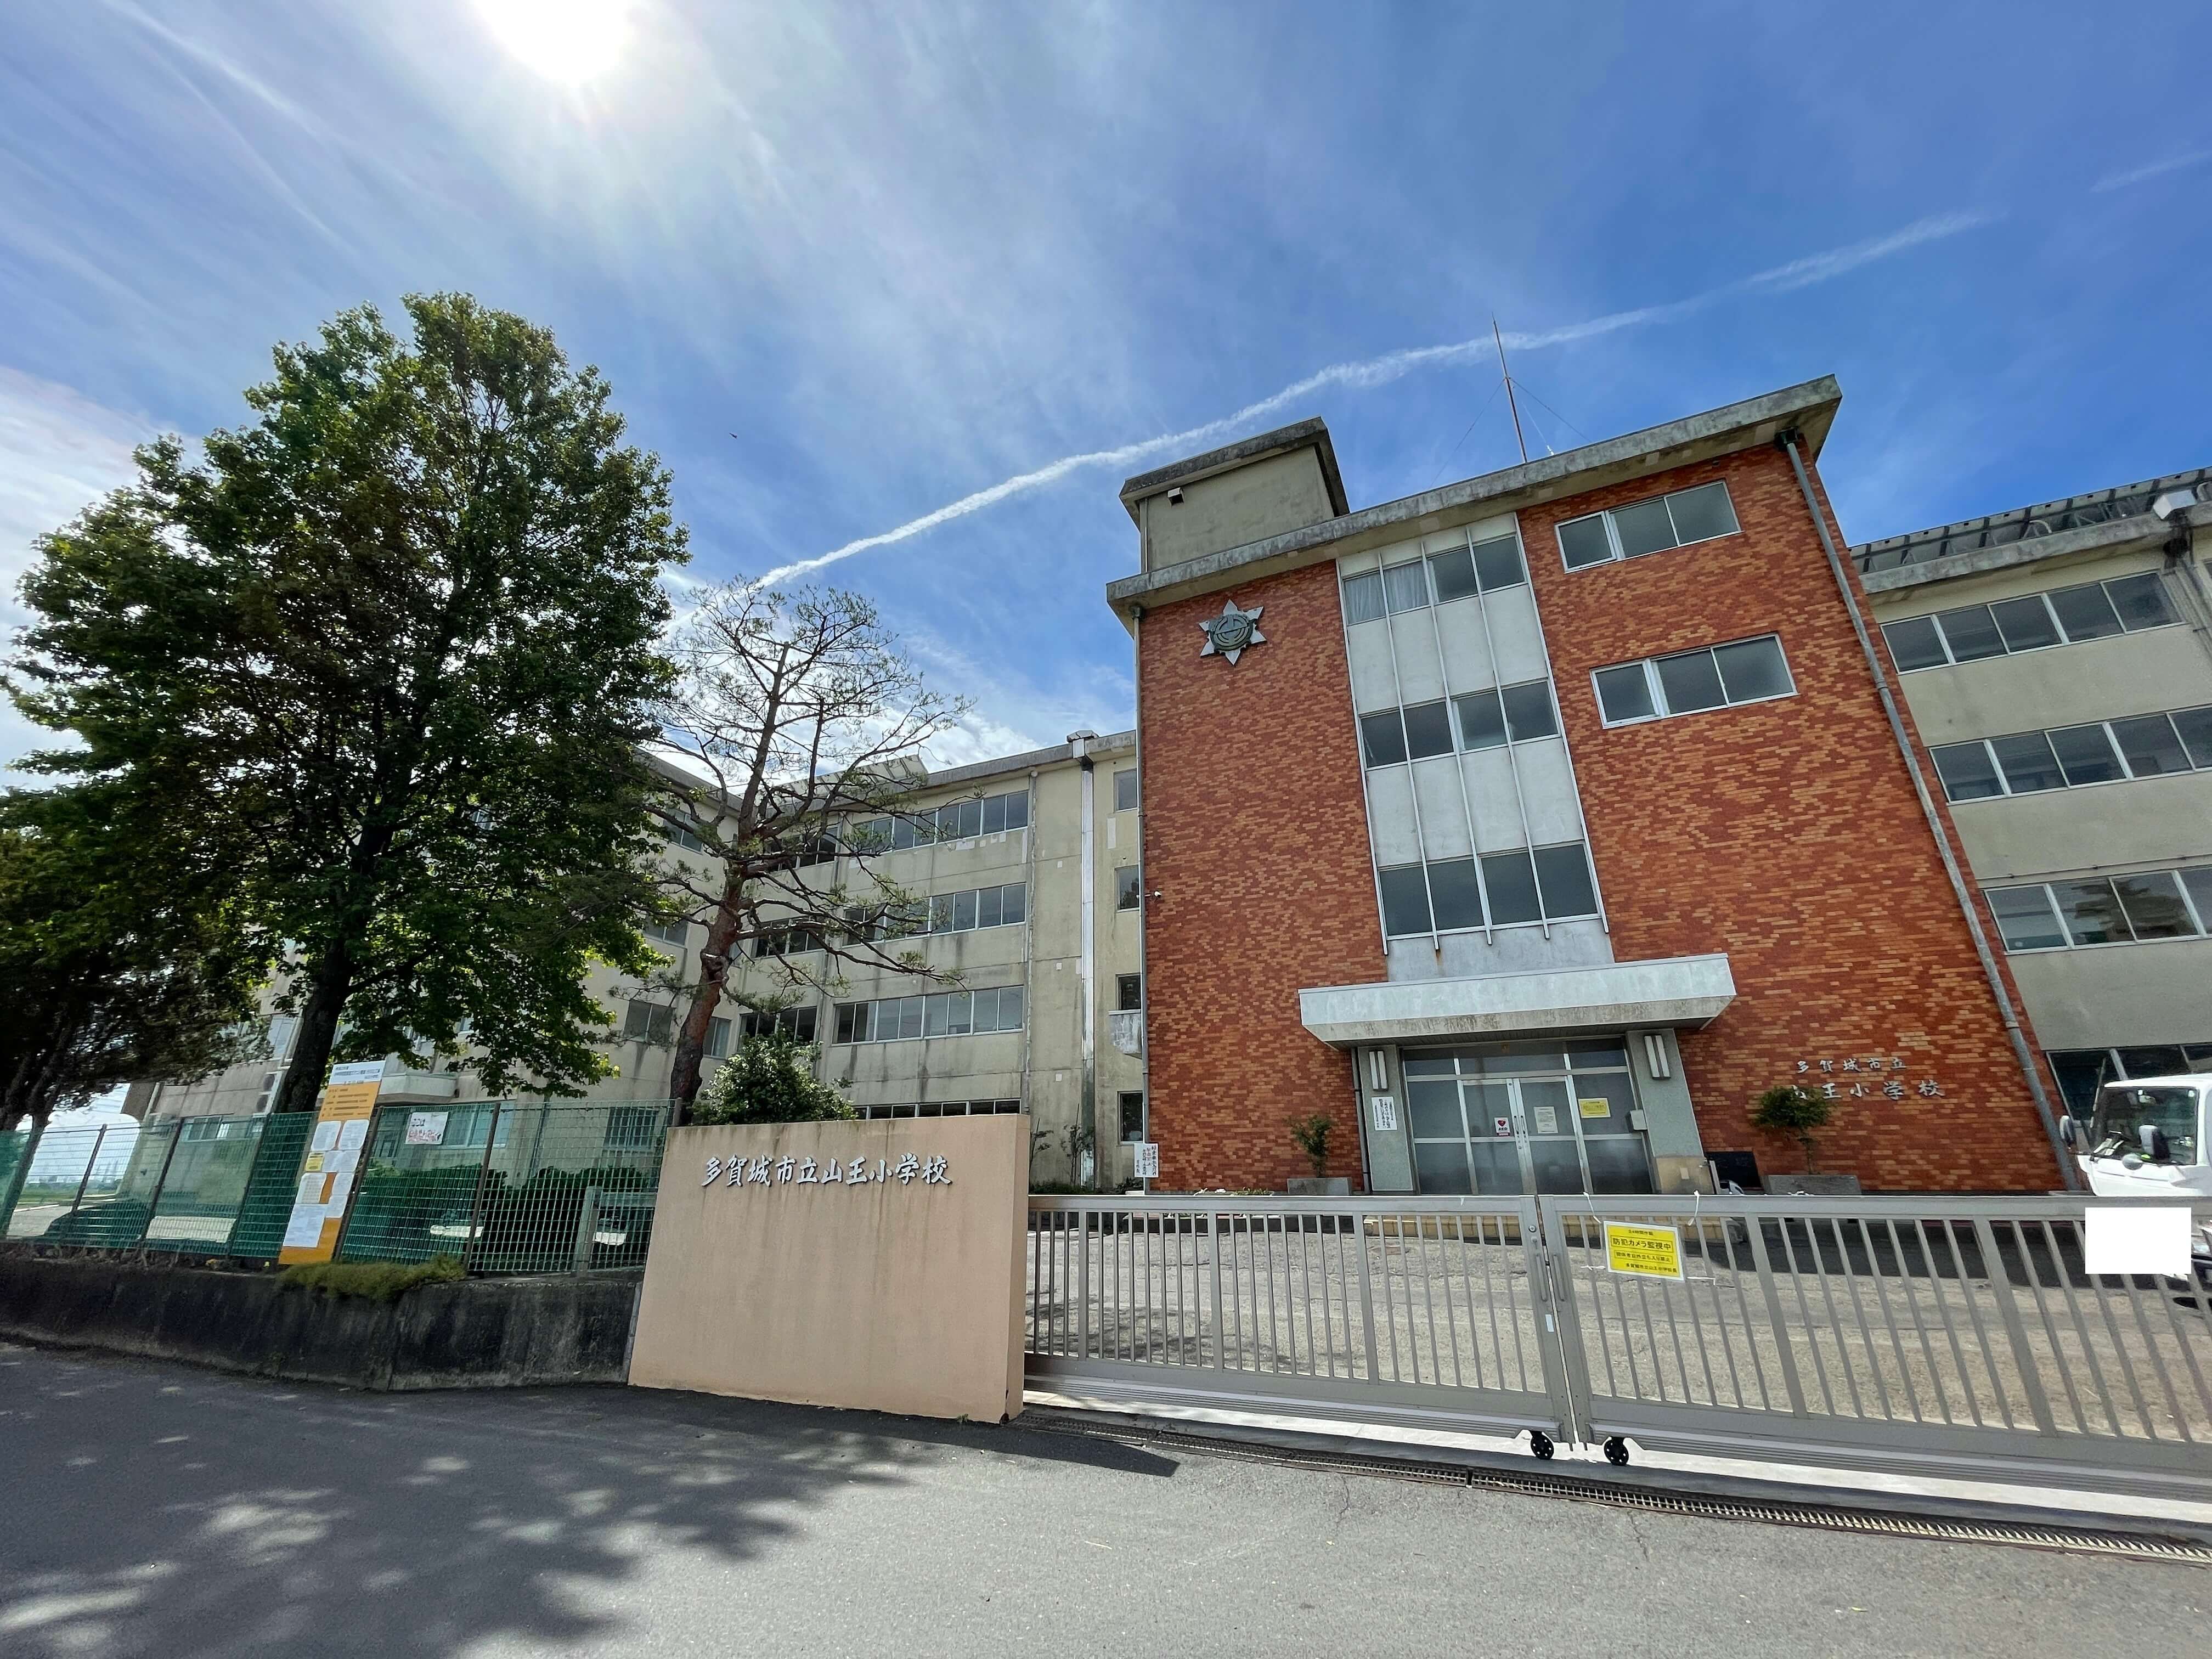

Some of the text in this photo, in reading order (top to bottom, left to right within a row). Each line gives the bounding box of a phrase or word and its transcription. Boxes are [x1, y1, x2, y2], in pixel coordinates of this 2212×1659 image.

[1797, 1057, 1907, 1074] 多賀城市立
[701, 1152, 953, 1187] 多賀城市立山王小学校
[1613, 1238, 1671, 1250] 防犯カメラ監視中
